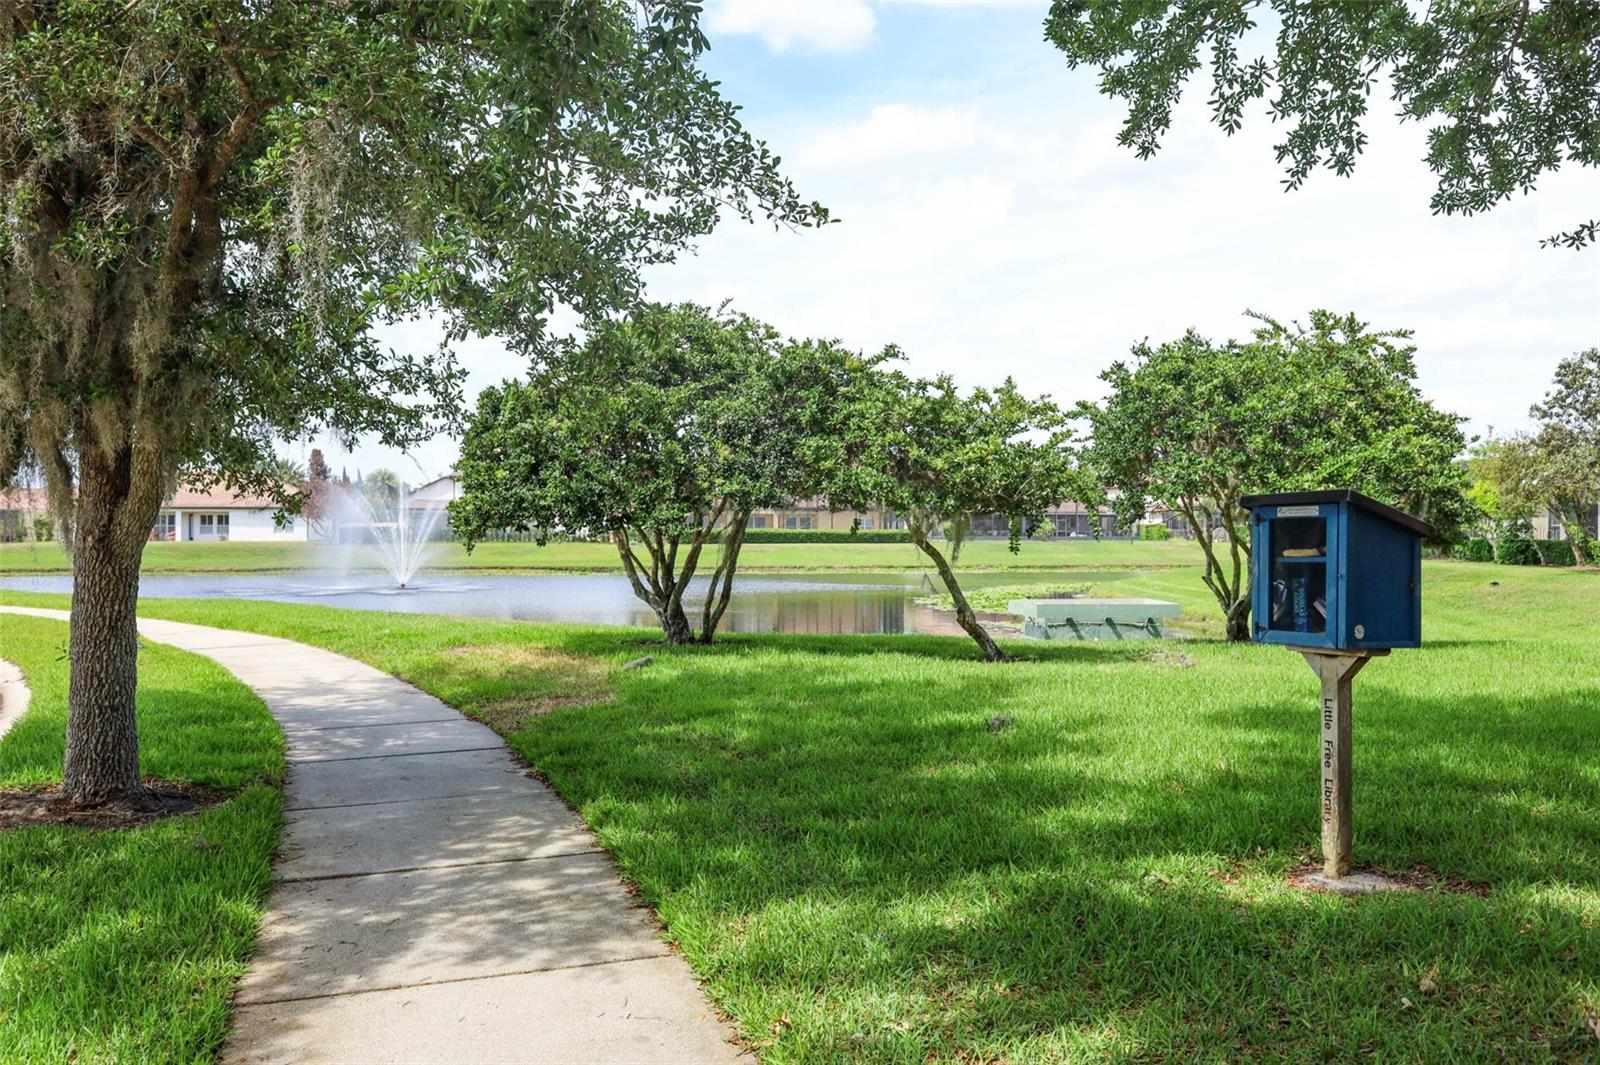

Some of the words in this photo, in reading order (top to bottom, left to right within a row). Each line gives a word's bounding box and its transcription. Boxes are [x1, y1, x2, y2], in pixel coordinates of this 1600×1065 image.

[1324, 698, 1333, 730] Little
[1324, 740, 1333, 768] Free
[1323, 779, 1333, 824] Library
